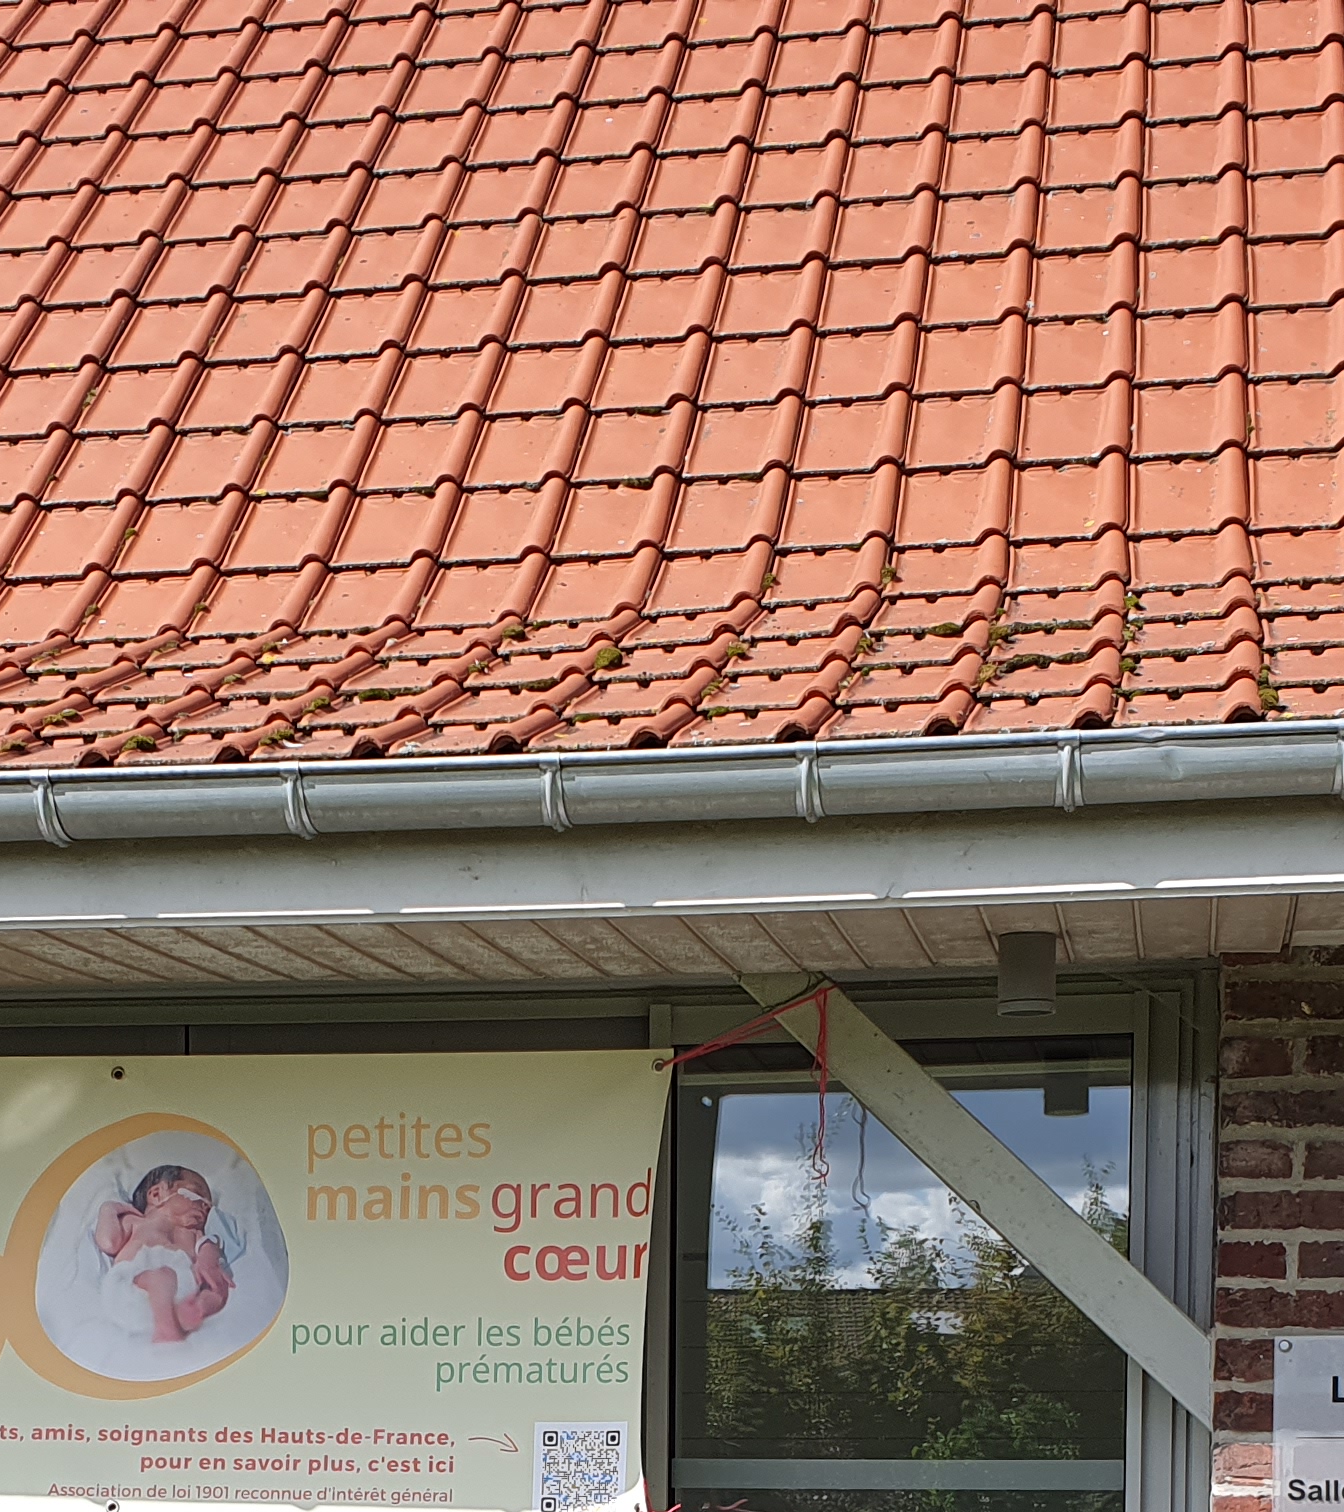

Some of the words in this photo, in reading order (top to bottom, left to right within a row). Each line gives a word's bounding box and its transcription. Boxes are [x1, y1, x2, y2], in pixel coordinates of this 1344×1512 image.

[307, 1112, 492, 1175] petites
[306, 1172, 481, 1221] mains
[491, 1167, 652, 1233] grand
[503, 1242, 648, 1281] cœur
[291, 1322, 369, 1354] pour
[380, 1317, 465, 1346] aider
[477, 1317, 521, 1347] les
[533, 1316, 631, 1347] bébés
[435, 1353, 629, 1392] prématurés
[31, 1424, 91, 1443] amis,
[97, 1425, 208, 1446] soignants
[214, 1427, 253, 1444] des
[260, 1427, 456, 1448] Hauts-de-France,
[140, 1456, 193, 1473] pour
[199, 1457, 226, 1471] en
[233, 1454, 302, 1472] savoir
[307, 1455, 361, 1475] plus,
[368, 1456, 421, 1473] c'est
[428, 1455, 455, 1473] ici
[47, 1483, 142, 1498] Association
[146, 1484, 167, 1498] de
[172, 1485, 191, 1499] loi
[195, 1486, 229, 1500] 1901
[234, 1488, 313, 1501] reconnue
[316, 1487, 387, 1502] d'intérêt
[390, 1488, 454, 1505] général
